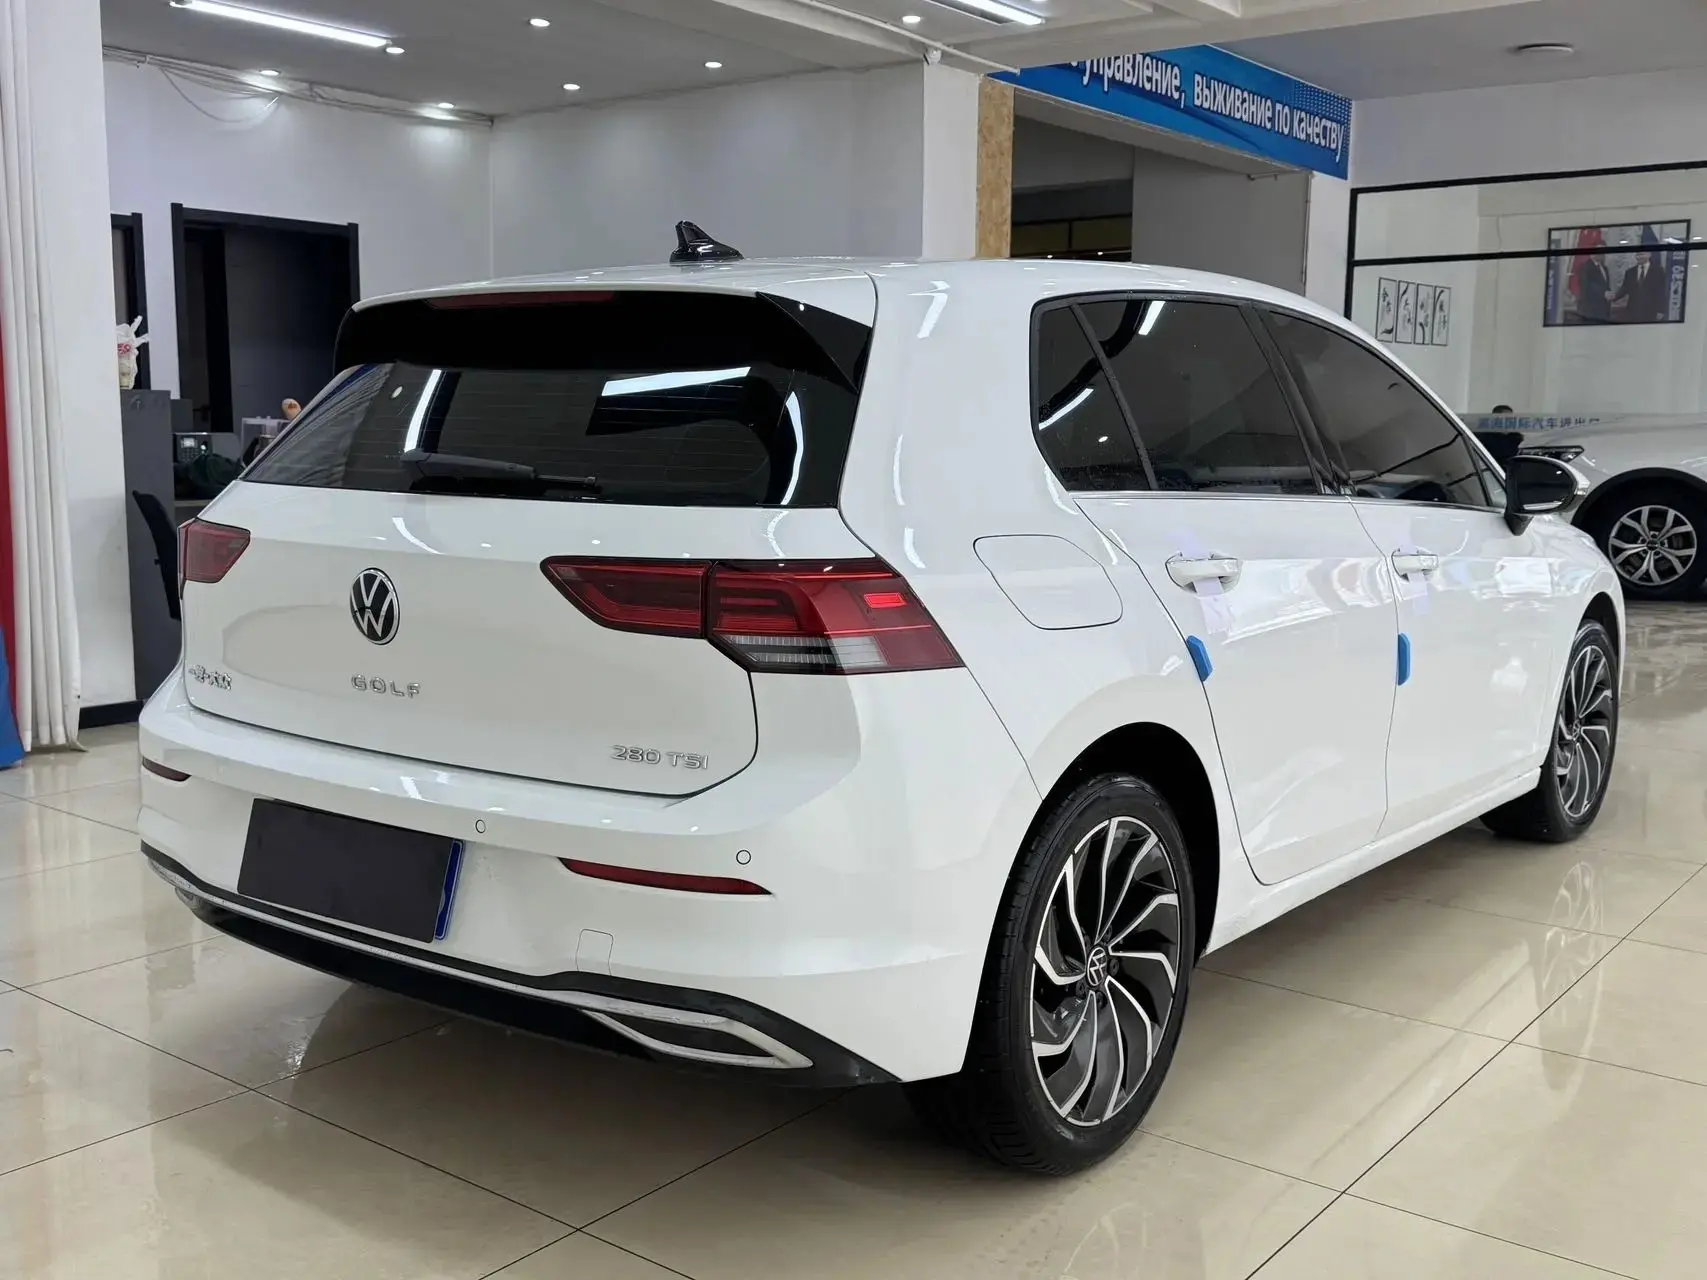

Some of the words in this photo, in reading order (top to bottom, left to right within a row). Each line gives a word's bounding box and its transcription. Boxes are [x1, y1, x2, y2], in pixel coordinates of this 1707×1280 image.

[1194, 73, 1272, 130] выживание
[1275, 102, 1290, 135] по
[1293, 108, 1345, 163] качеству
[350, 568, 399, 643] VW
[351, 674, 420, 698] GOLF
[610, 745, 661, 765] 280
[666, 752, 709, 769] TSI
